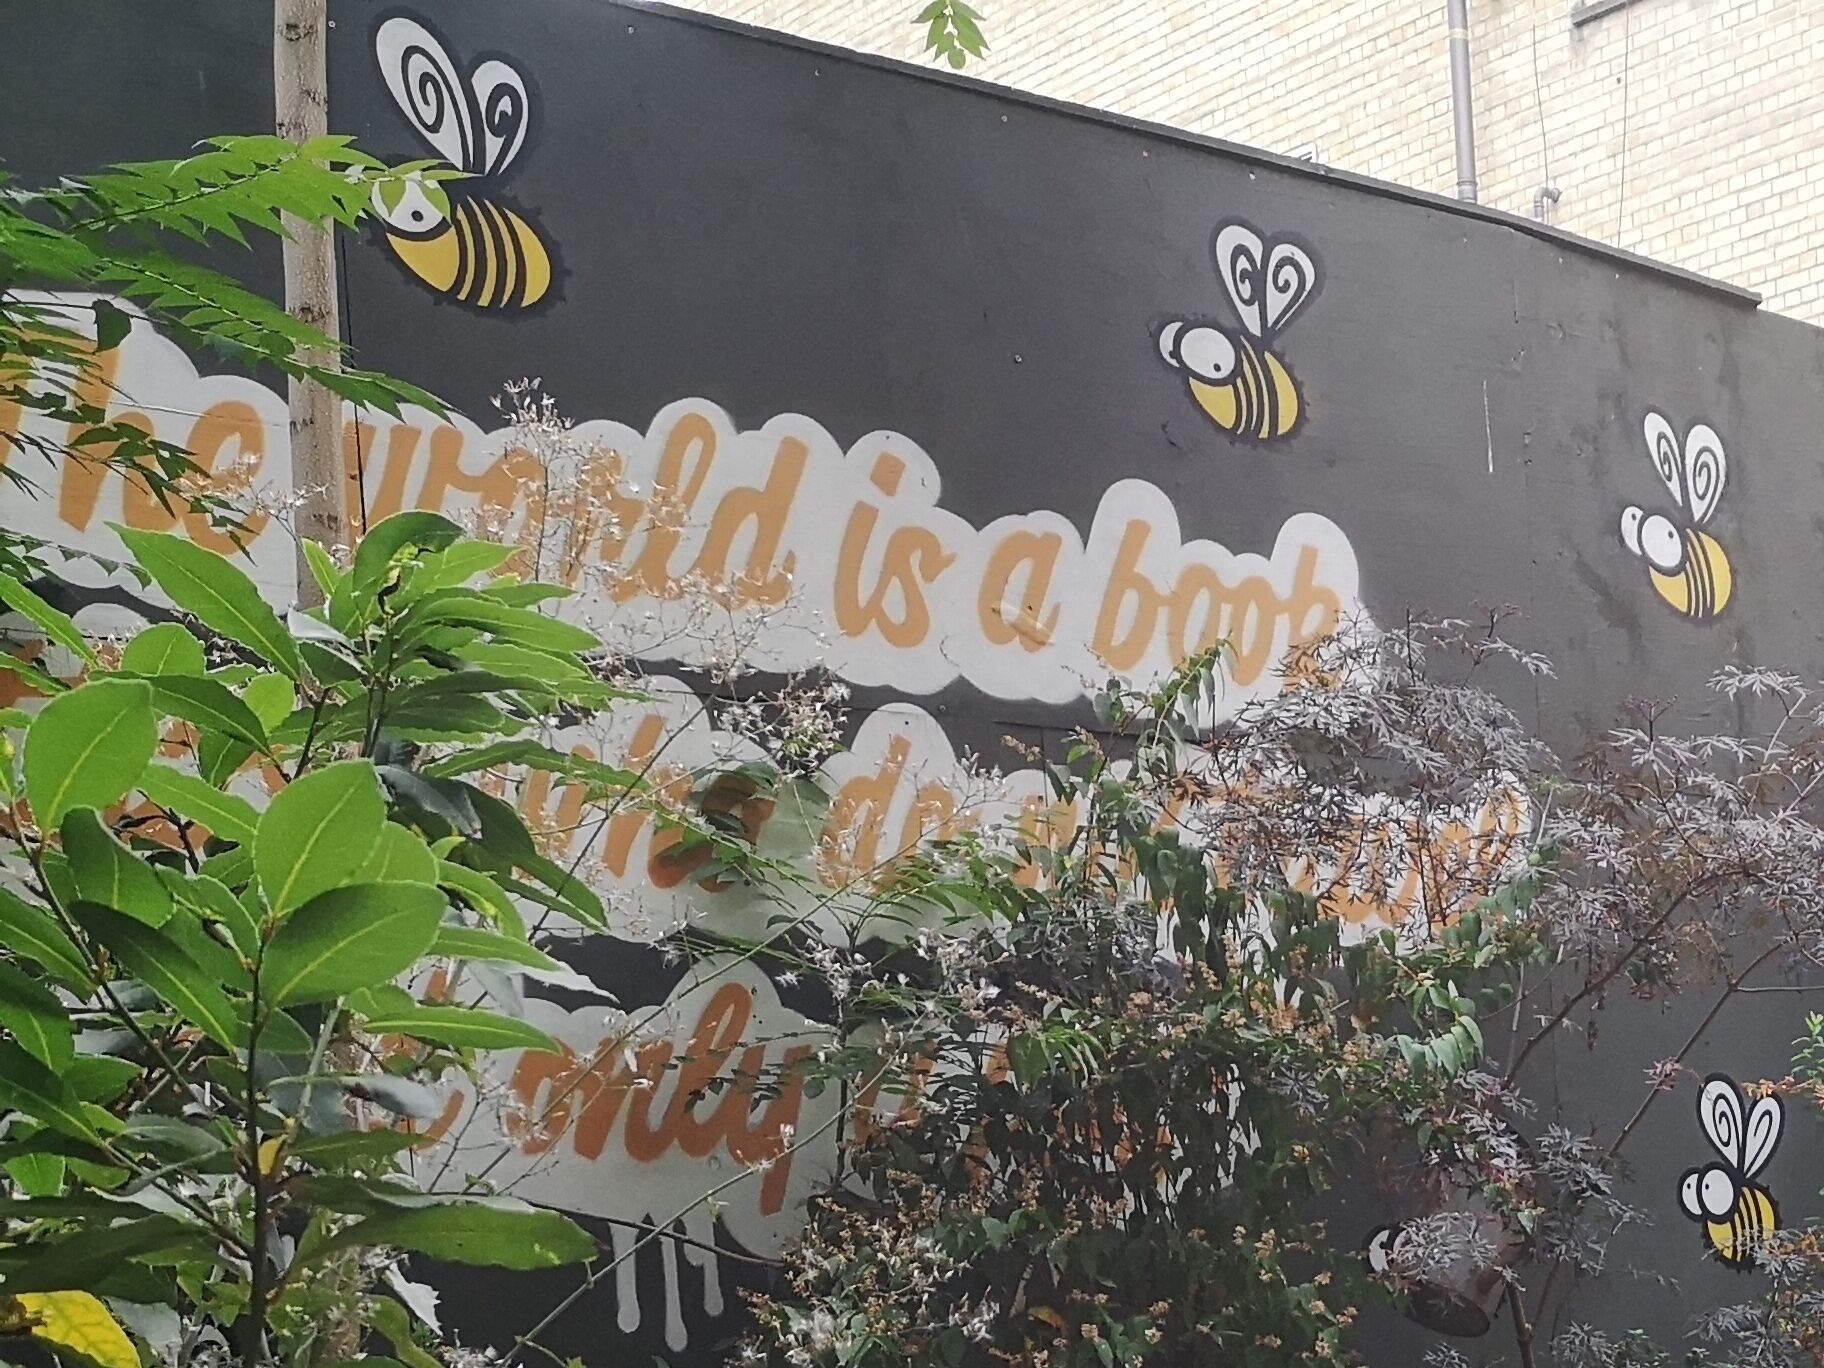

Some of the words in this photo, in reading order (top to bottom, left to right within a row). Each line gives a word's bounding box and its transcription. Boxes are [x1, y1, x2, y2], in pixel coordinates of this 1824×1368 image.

[342, 411, 809, 610] world
[834, 452, 957, 648] is
[978, 530, 1062, 652] a
[505, 982, 811, 1217] only
